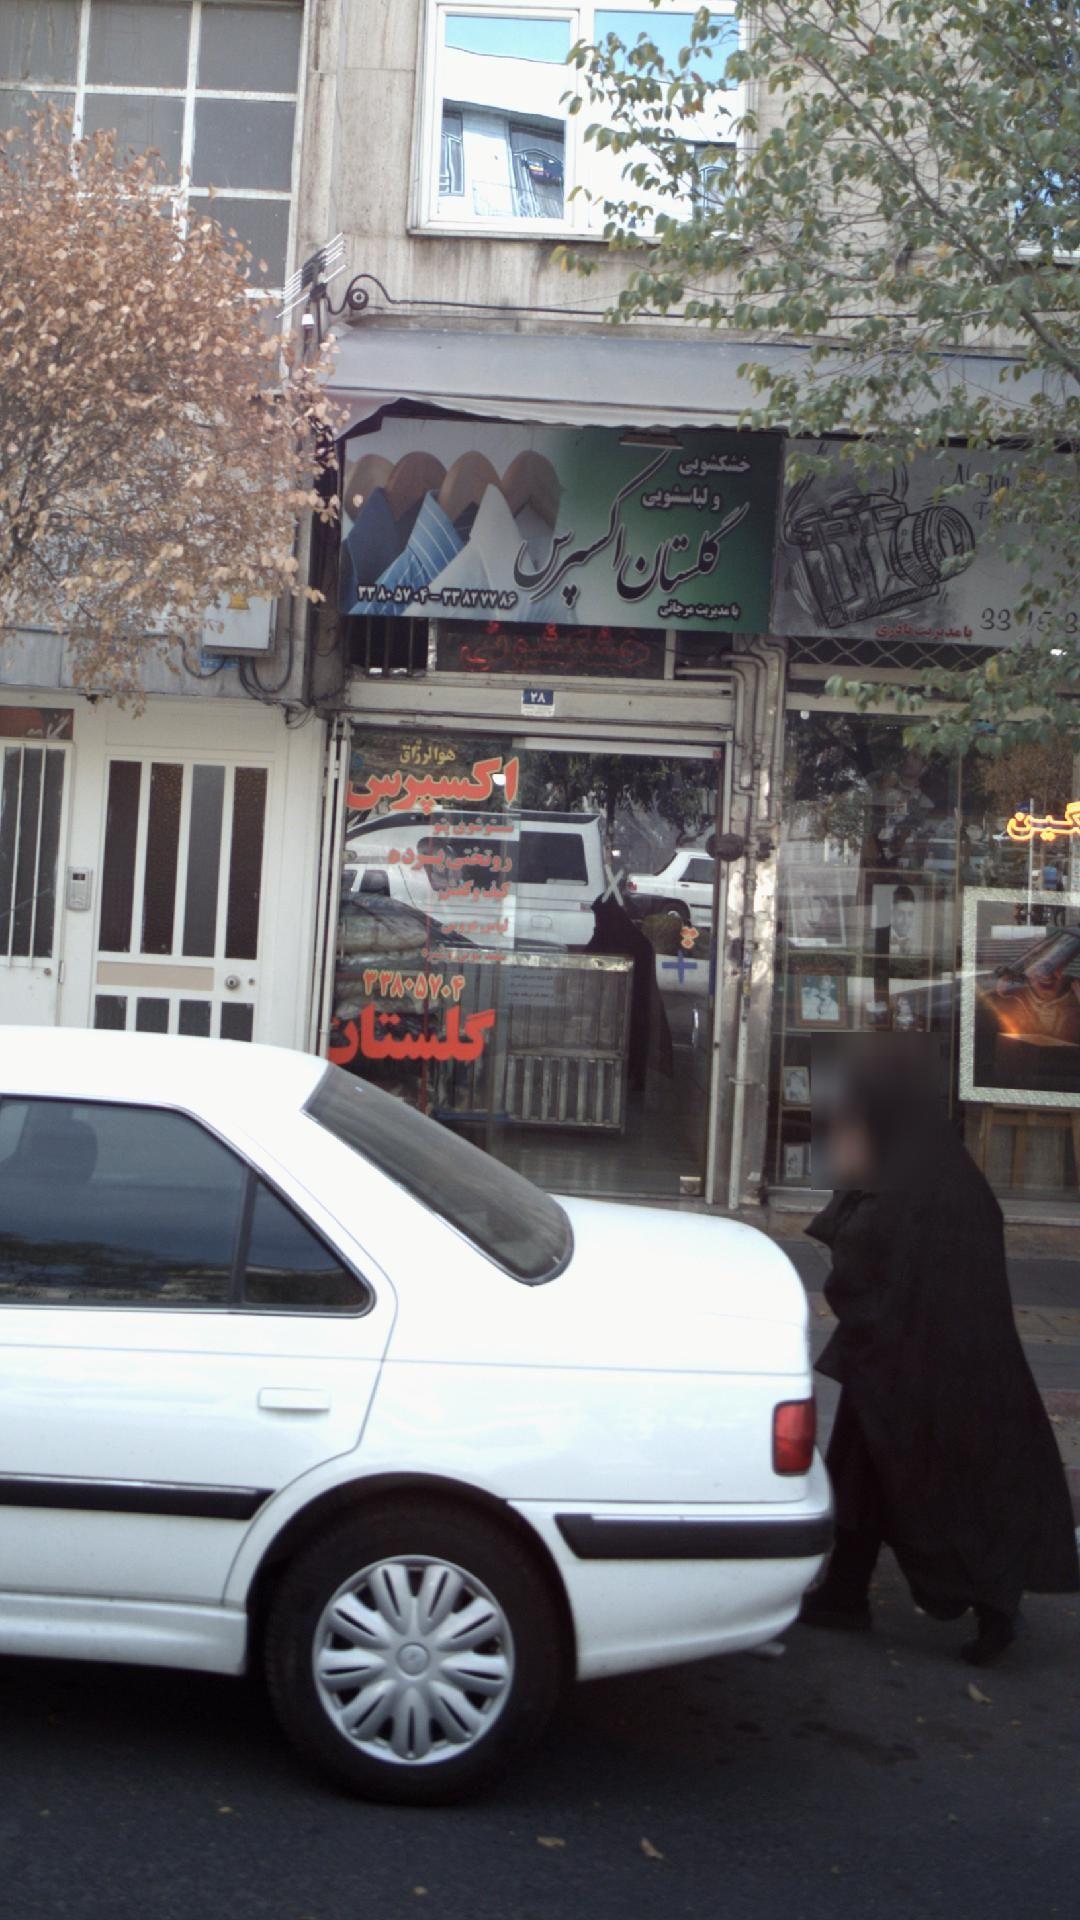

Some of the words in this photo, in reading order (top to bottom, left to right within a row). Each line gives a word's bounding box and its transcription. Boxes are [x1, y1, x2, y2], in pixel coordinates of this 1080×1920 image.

[678, 454, 751, 477] خشکشویی
[513, 449, 672, 608] اکسپرس
[616, 501, 749, 603] گلستان
[530, 691, 546, 703] ۲۸
[347, 756, 519, 815] اکسپرس
[362, 969, 467, 1003] ۳۳۸۰۵۷۰۴
[328, 1004, 496, 1066] گلستان
